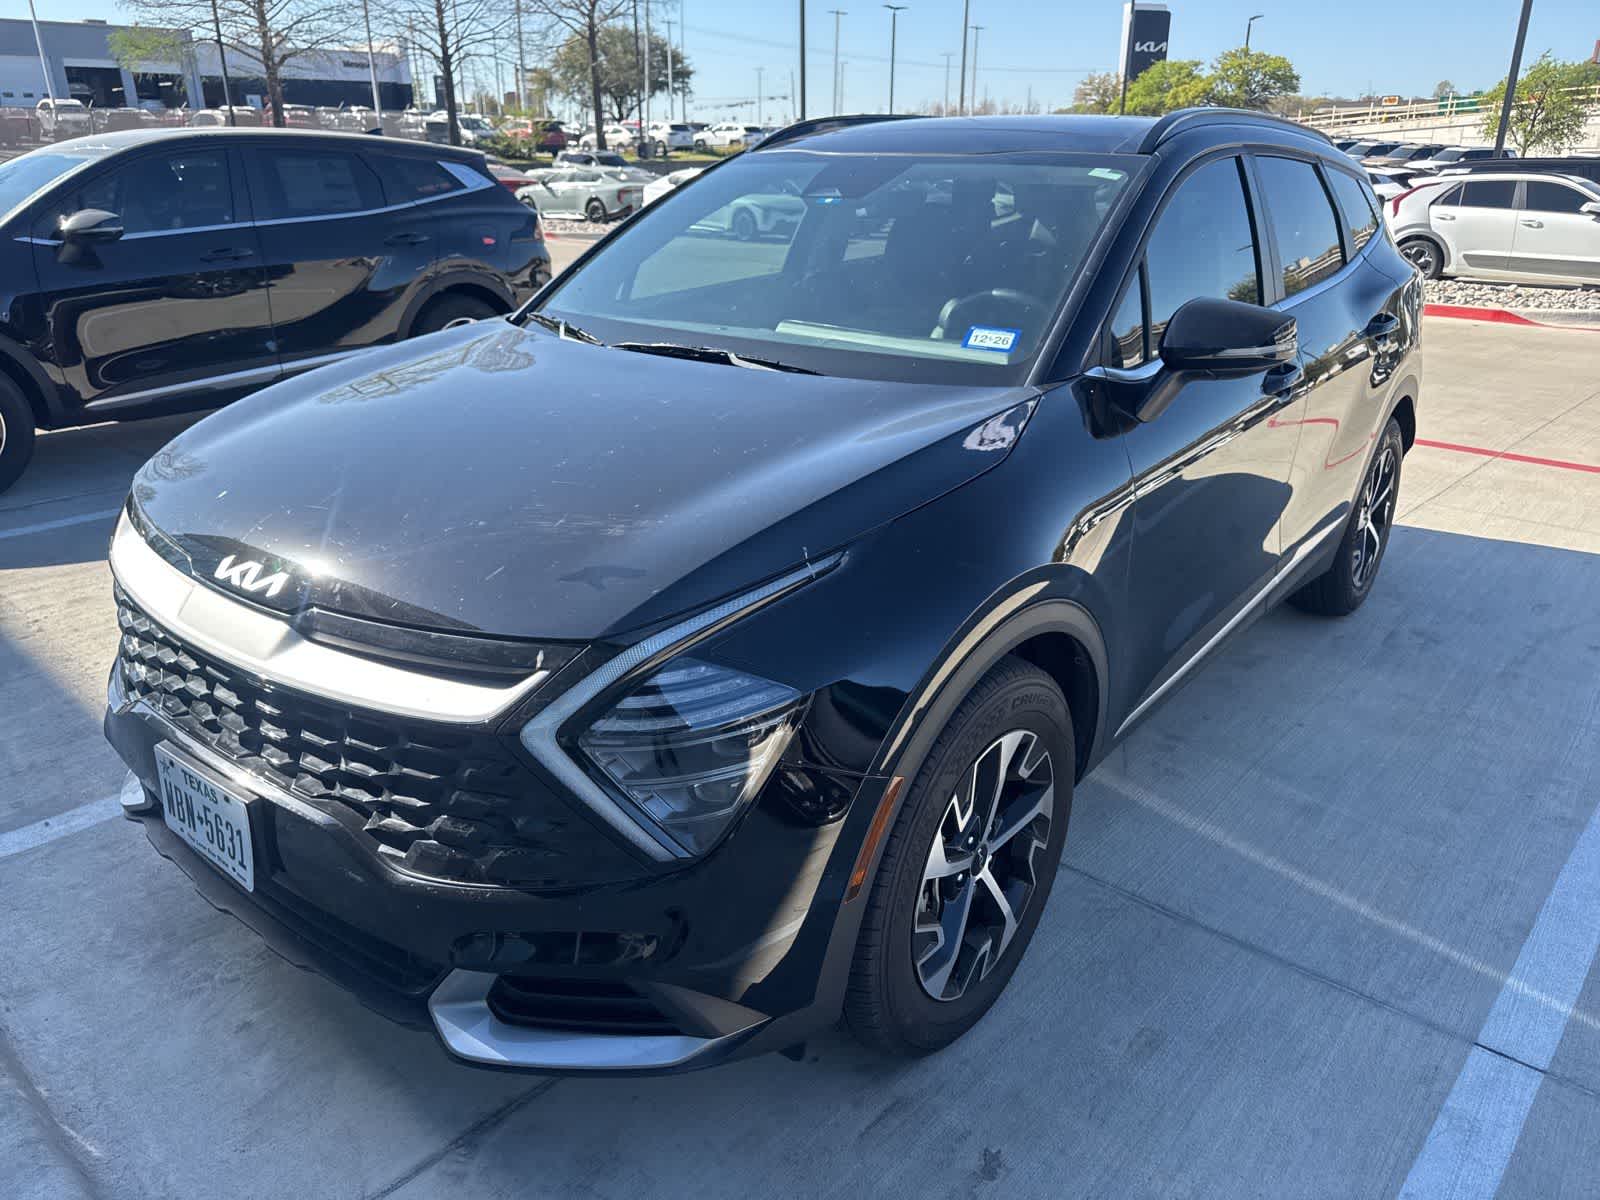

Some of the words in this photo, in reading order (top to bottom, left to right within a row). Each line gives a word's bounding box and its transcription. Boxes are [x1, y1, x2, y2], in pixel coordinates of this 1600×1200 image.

[1135, 40, 1167, 53] KIA
[213, 554, 290, 598] KIA
[181, 769, 218, 805] TEXAS
